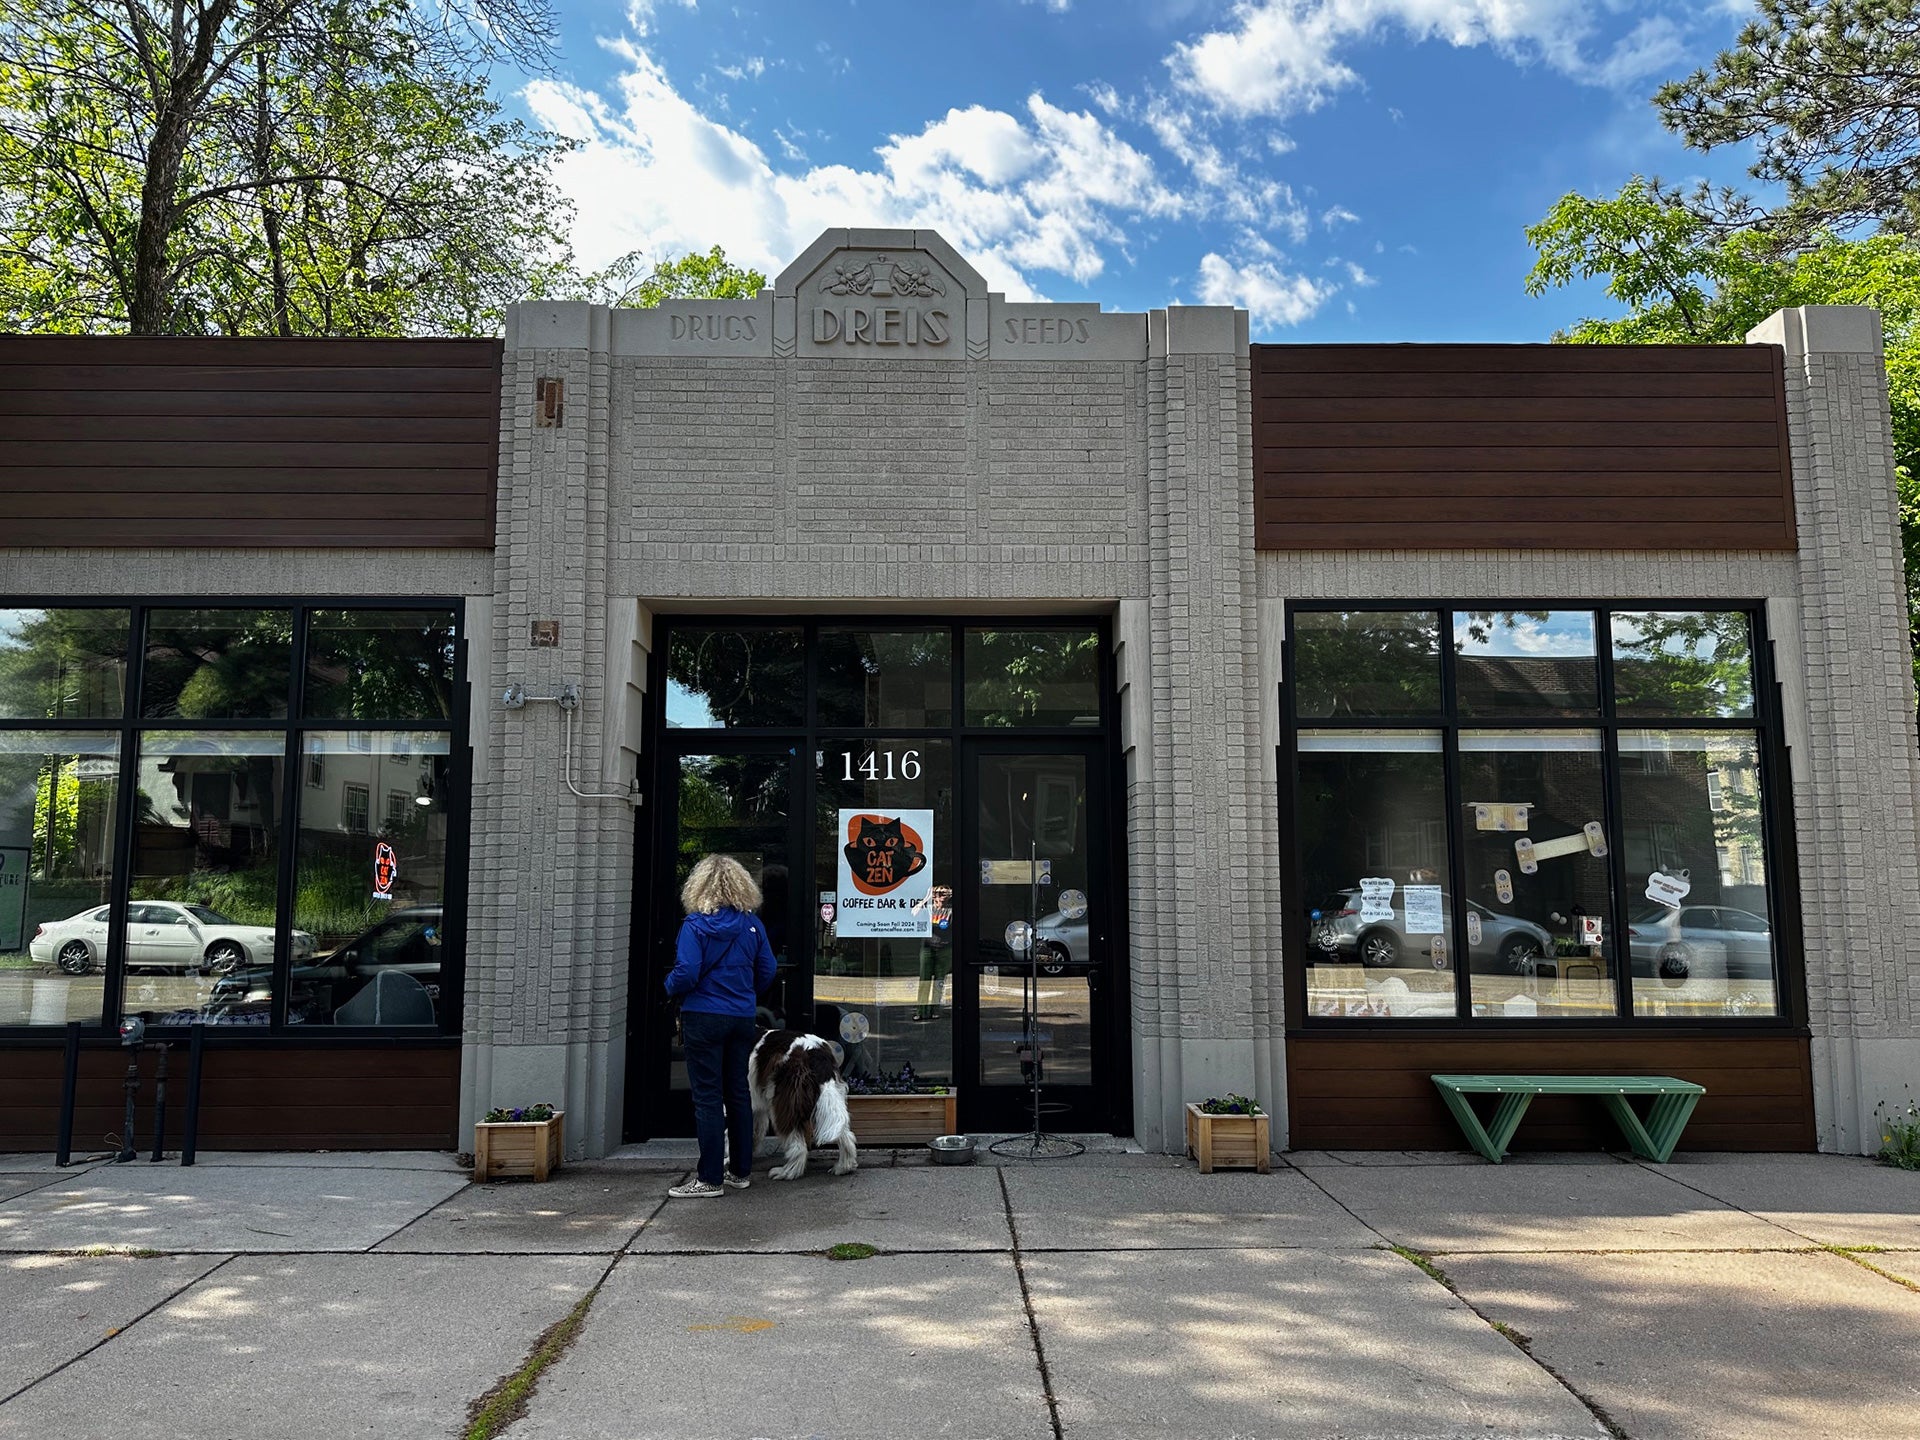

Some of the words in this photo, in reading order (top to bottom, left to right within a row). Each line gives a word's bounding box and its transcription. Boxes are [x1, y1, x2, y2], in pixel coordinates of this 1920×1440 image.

[670, 314, 757, 342] DRUGS
[812, 306, 950, 345] DREIS
[1004, 318, 1090, 344] SEEDS
[841, 750, 921, 781] 1416
[867, 850, 894, 866] CAT
[866, 867, 893, 883] ZEN
[842, 898, 874, 908] COFFEE
[877, 898, 897, 909] BAR
[899, 899, 907, 908] &
